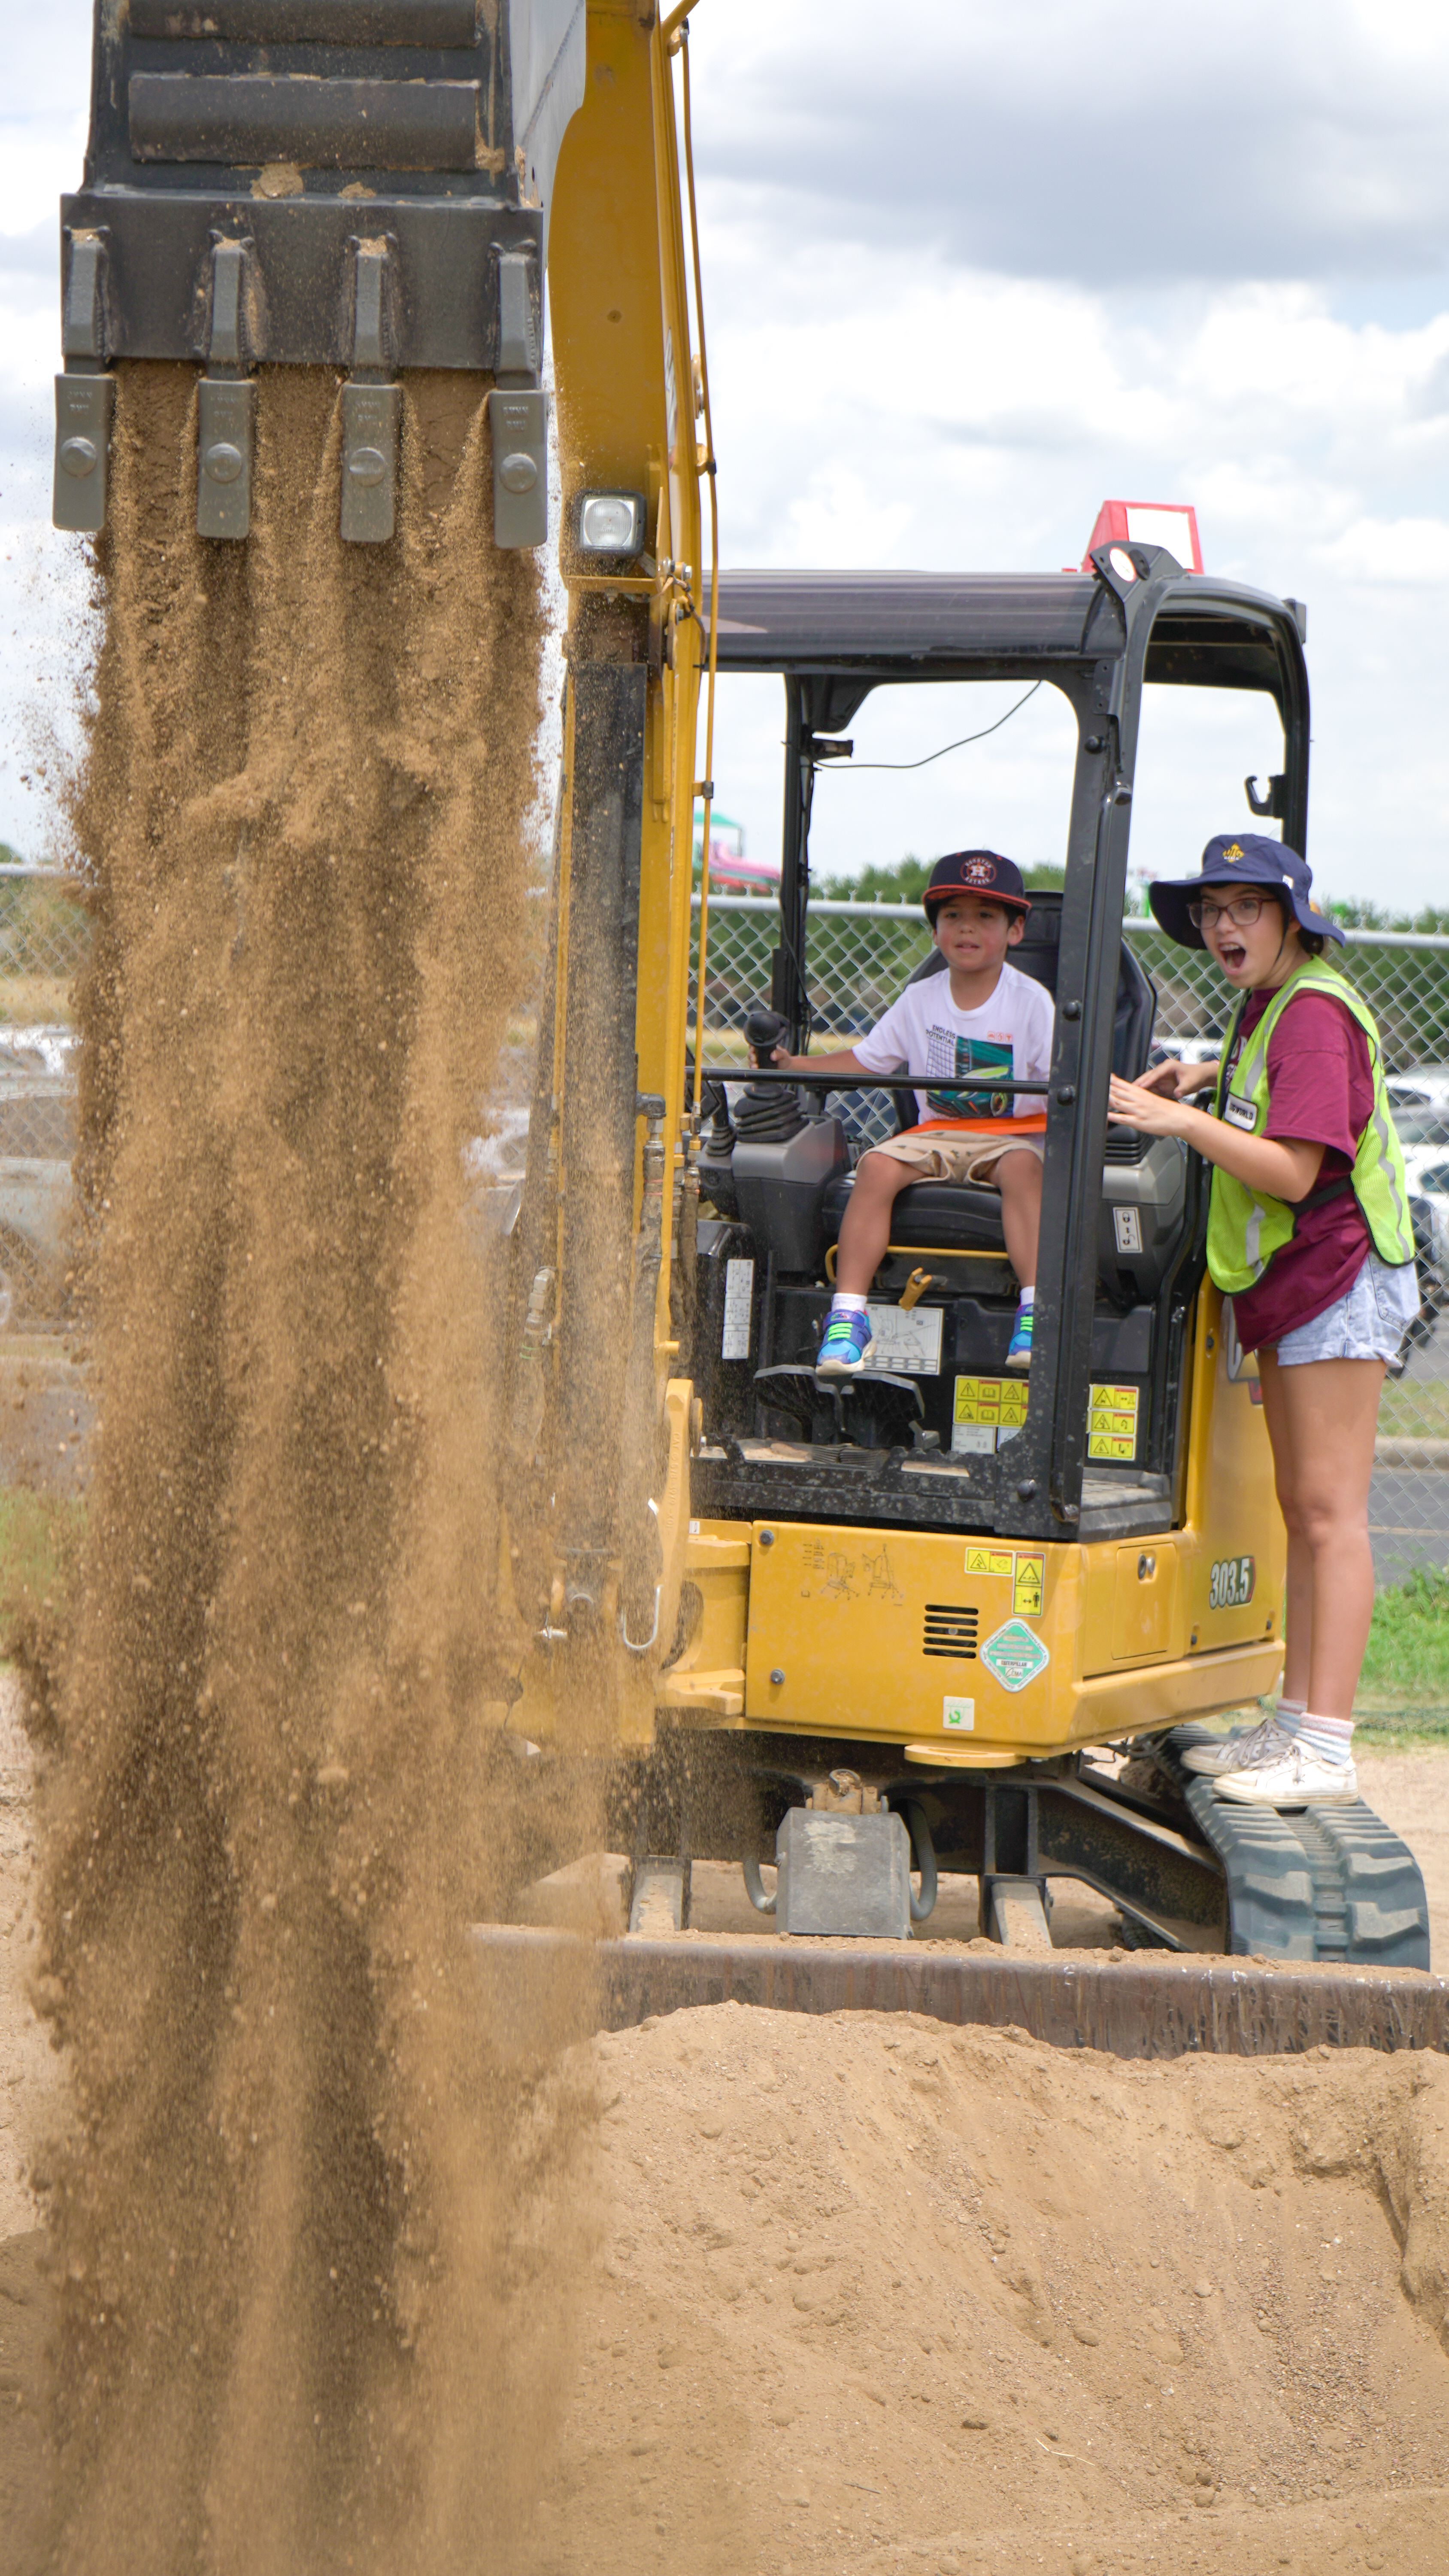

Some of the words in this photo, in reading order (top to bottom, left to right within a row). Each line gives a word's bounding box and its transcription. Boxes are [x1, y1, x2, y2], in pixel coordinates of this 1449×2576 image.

[965, 858, 991, 868] HOUSTON
[970, 865, 986, 877] H
[965, 876, 989, 885] ASTROS
[925, 1029, 955, 1047] POTENTIAL
[932, 1024, 956, 1039] ENDLESS
[1210, 1558, 1250, 1609] 303.5
